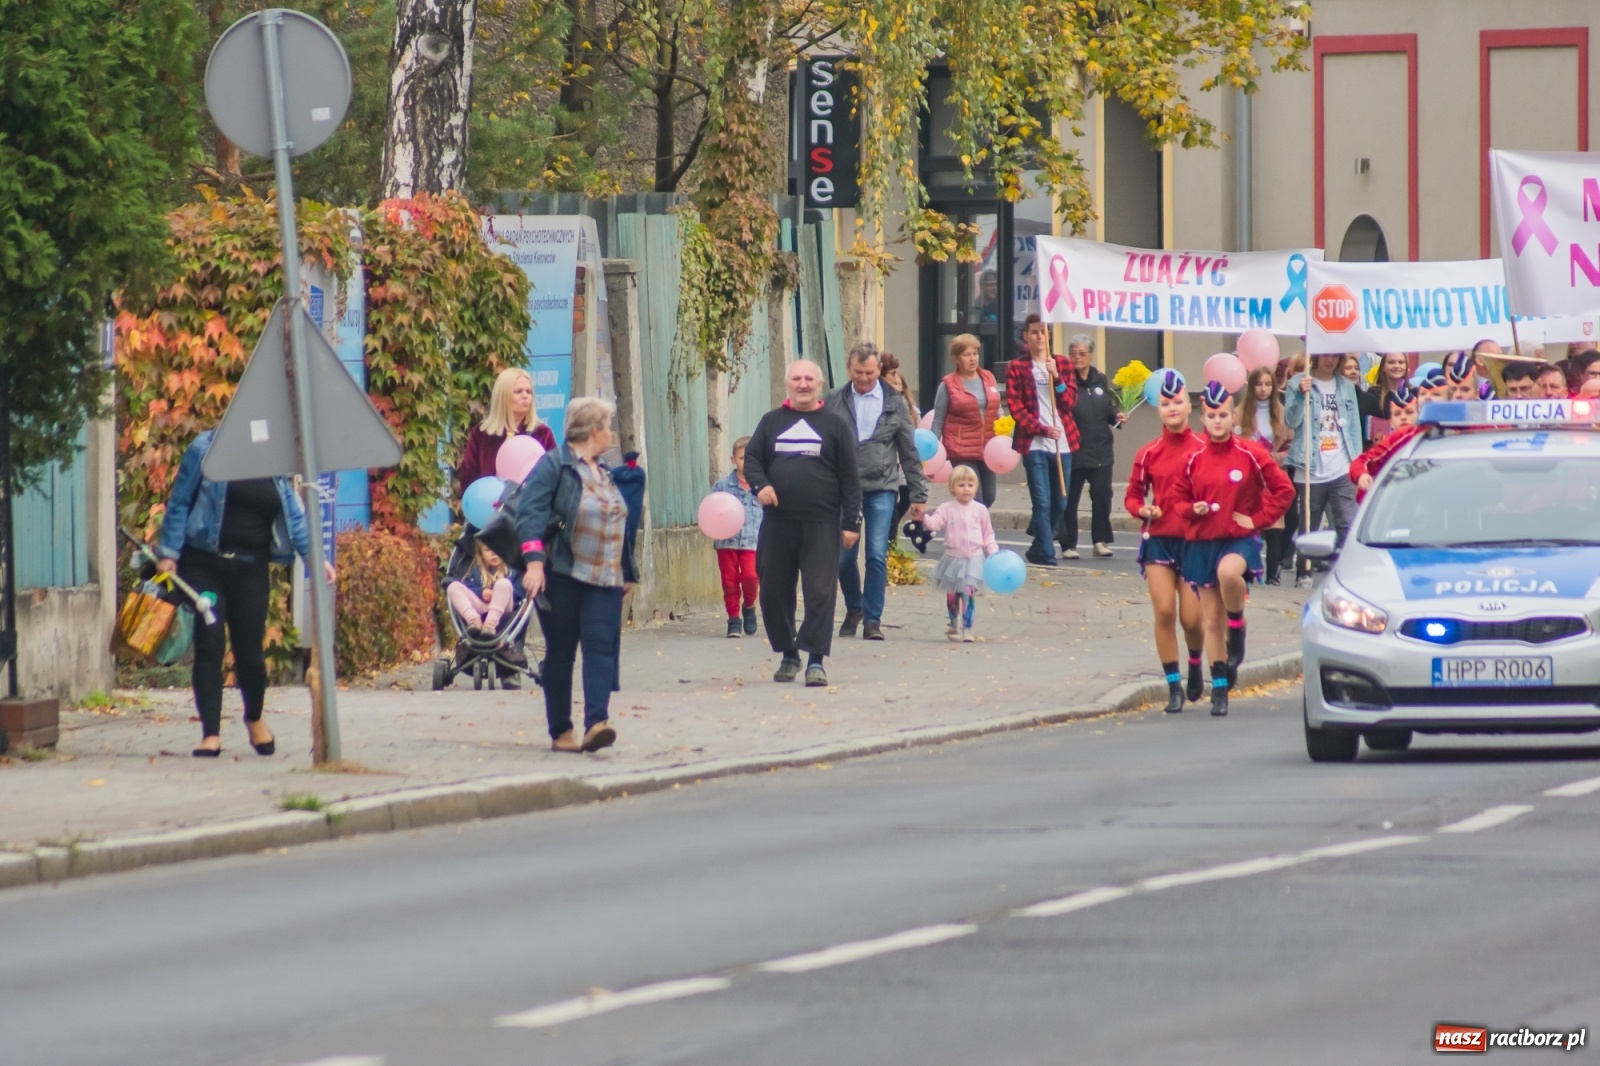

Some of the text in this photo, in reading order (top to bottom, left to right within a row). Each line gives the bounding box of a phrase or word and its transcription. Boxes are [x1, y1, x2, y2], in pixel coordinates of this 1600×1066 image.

[811, 60, 834, 202] sense
[1124, 251, 1229, 288] ZDĄŻYĆ
[1082, 288, 1273, 330] PRZED RAKIEM
[1318, 284, 1535, 330] STOP NOWOTW
[1491, 403, 1565, 420] POLICJA
[1436, 579, 1558, 595] POLICJA
[1447, 659, 1546, 681] HPP R006
